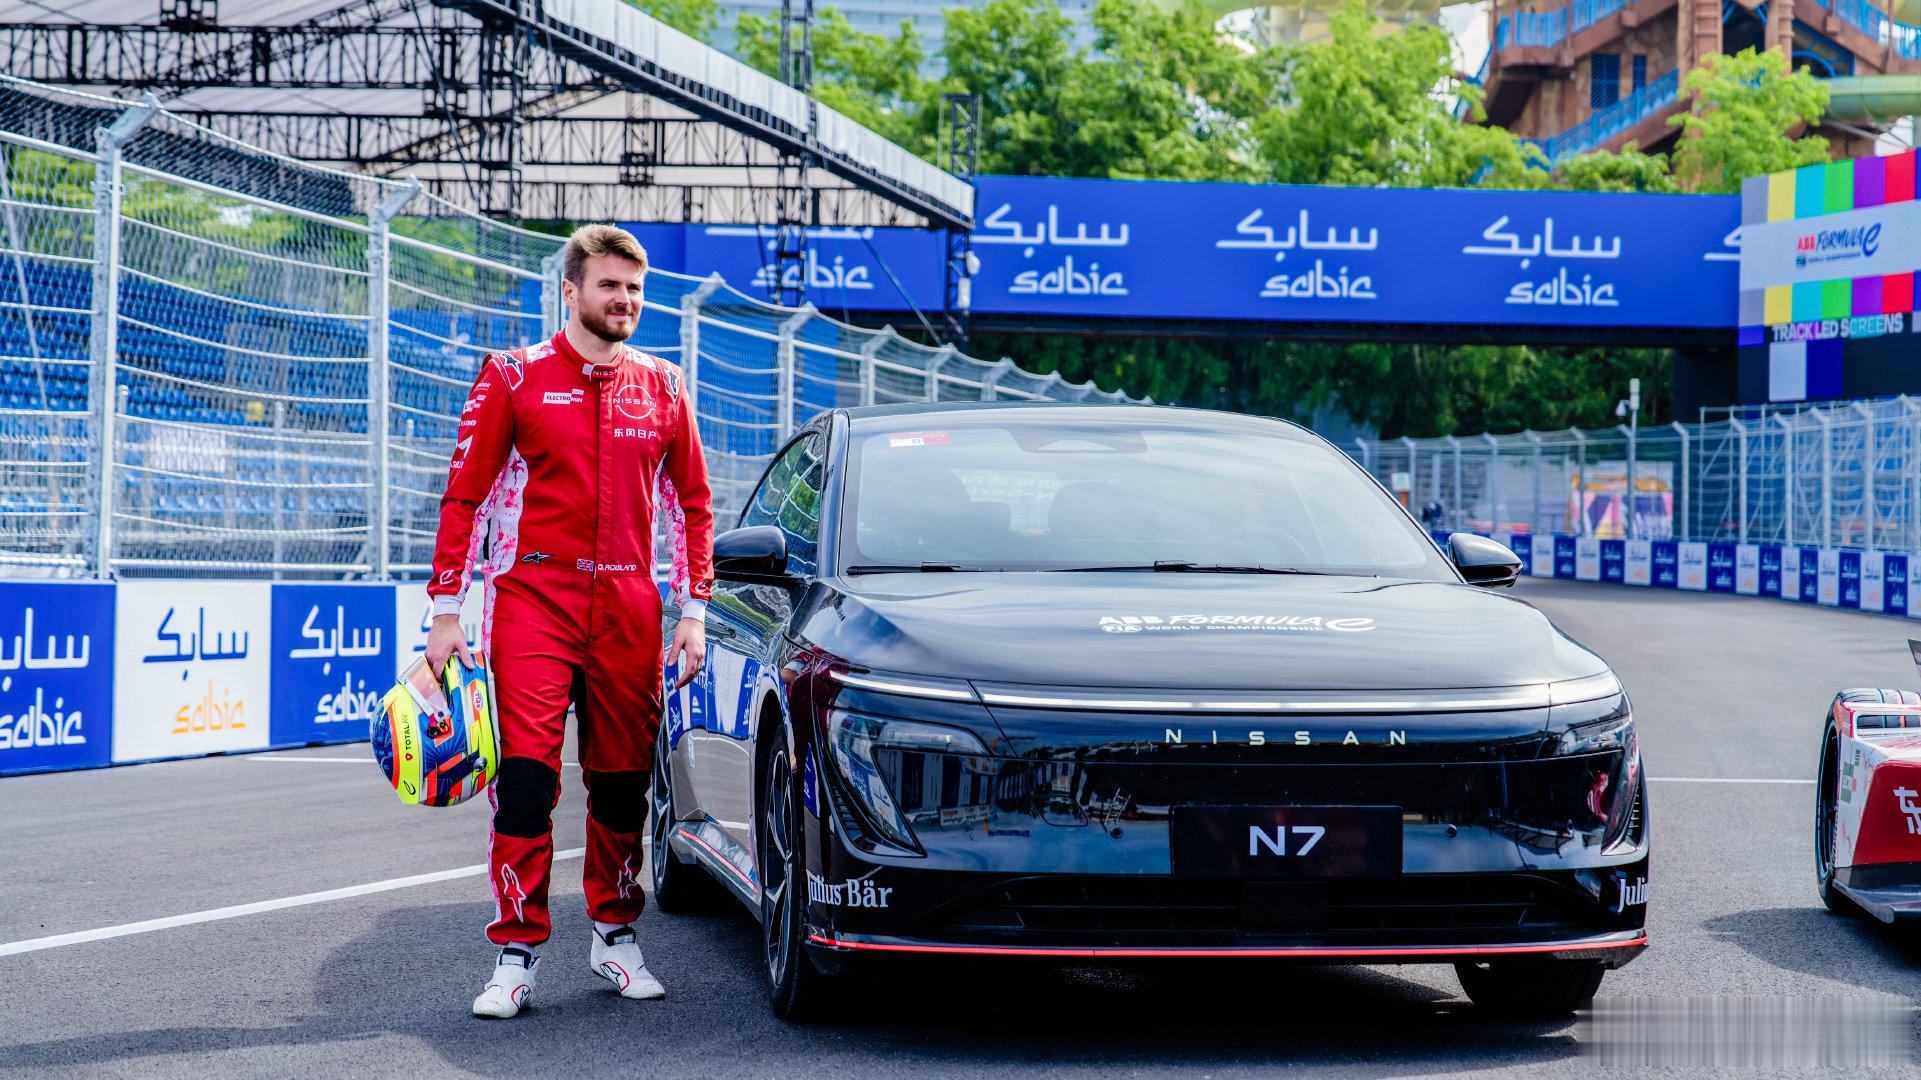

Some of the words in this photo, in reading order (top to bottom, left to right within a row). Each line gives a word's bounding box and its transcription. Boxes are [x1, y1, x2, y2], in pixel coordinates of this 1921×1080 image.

[969, 203, 1129, 258] سابك
[1216, 208, 1378, 262] سابك
[1462, 215, 1620, 268] سابك
[1008, 255, 1129, 295] sabic
[1260, 259, 1377, 299] sabic
[1505, 266, 1620, 306] sabic
[1772, 322, 1816, 342] TRACK
[1816, 319, 1839, 340] LED
[1840, 312, 1904, 338] SCREENS
[613, 397, 657, 407] NISSAN
[613, 428, 657, 440] 东风日产
[290, 605, 381, 675] سابك
[1098, 615, 1164, 625] ABB
[143, 606, 248, 682] سابك
[171, 678, 247, 735] sabic
[314, 671, 378, 723] sabic
[1165, 728, 1406, 746] NISSAN
[1250, 826, 1326, 856] N7
[806, 868, 842, 906] Julius
[846, 878, 893, 908] Bär
